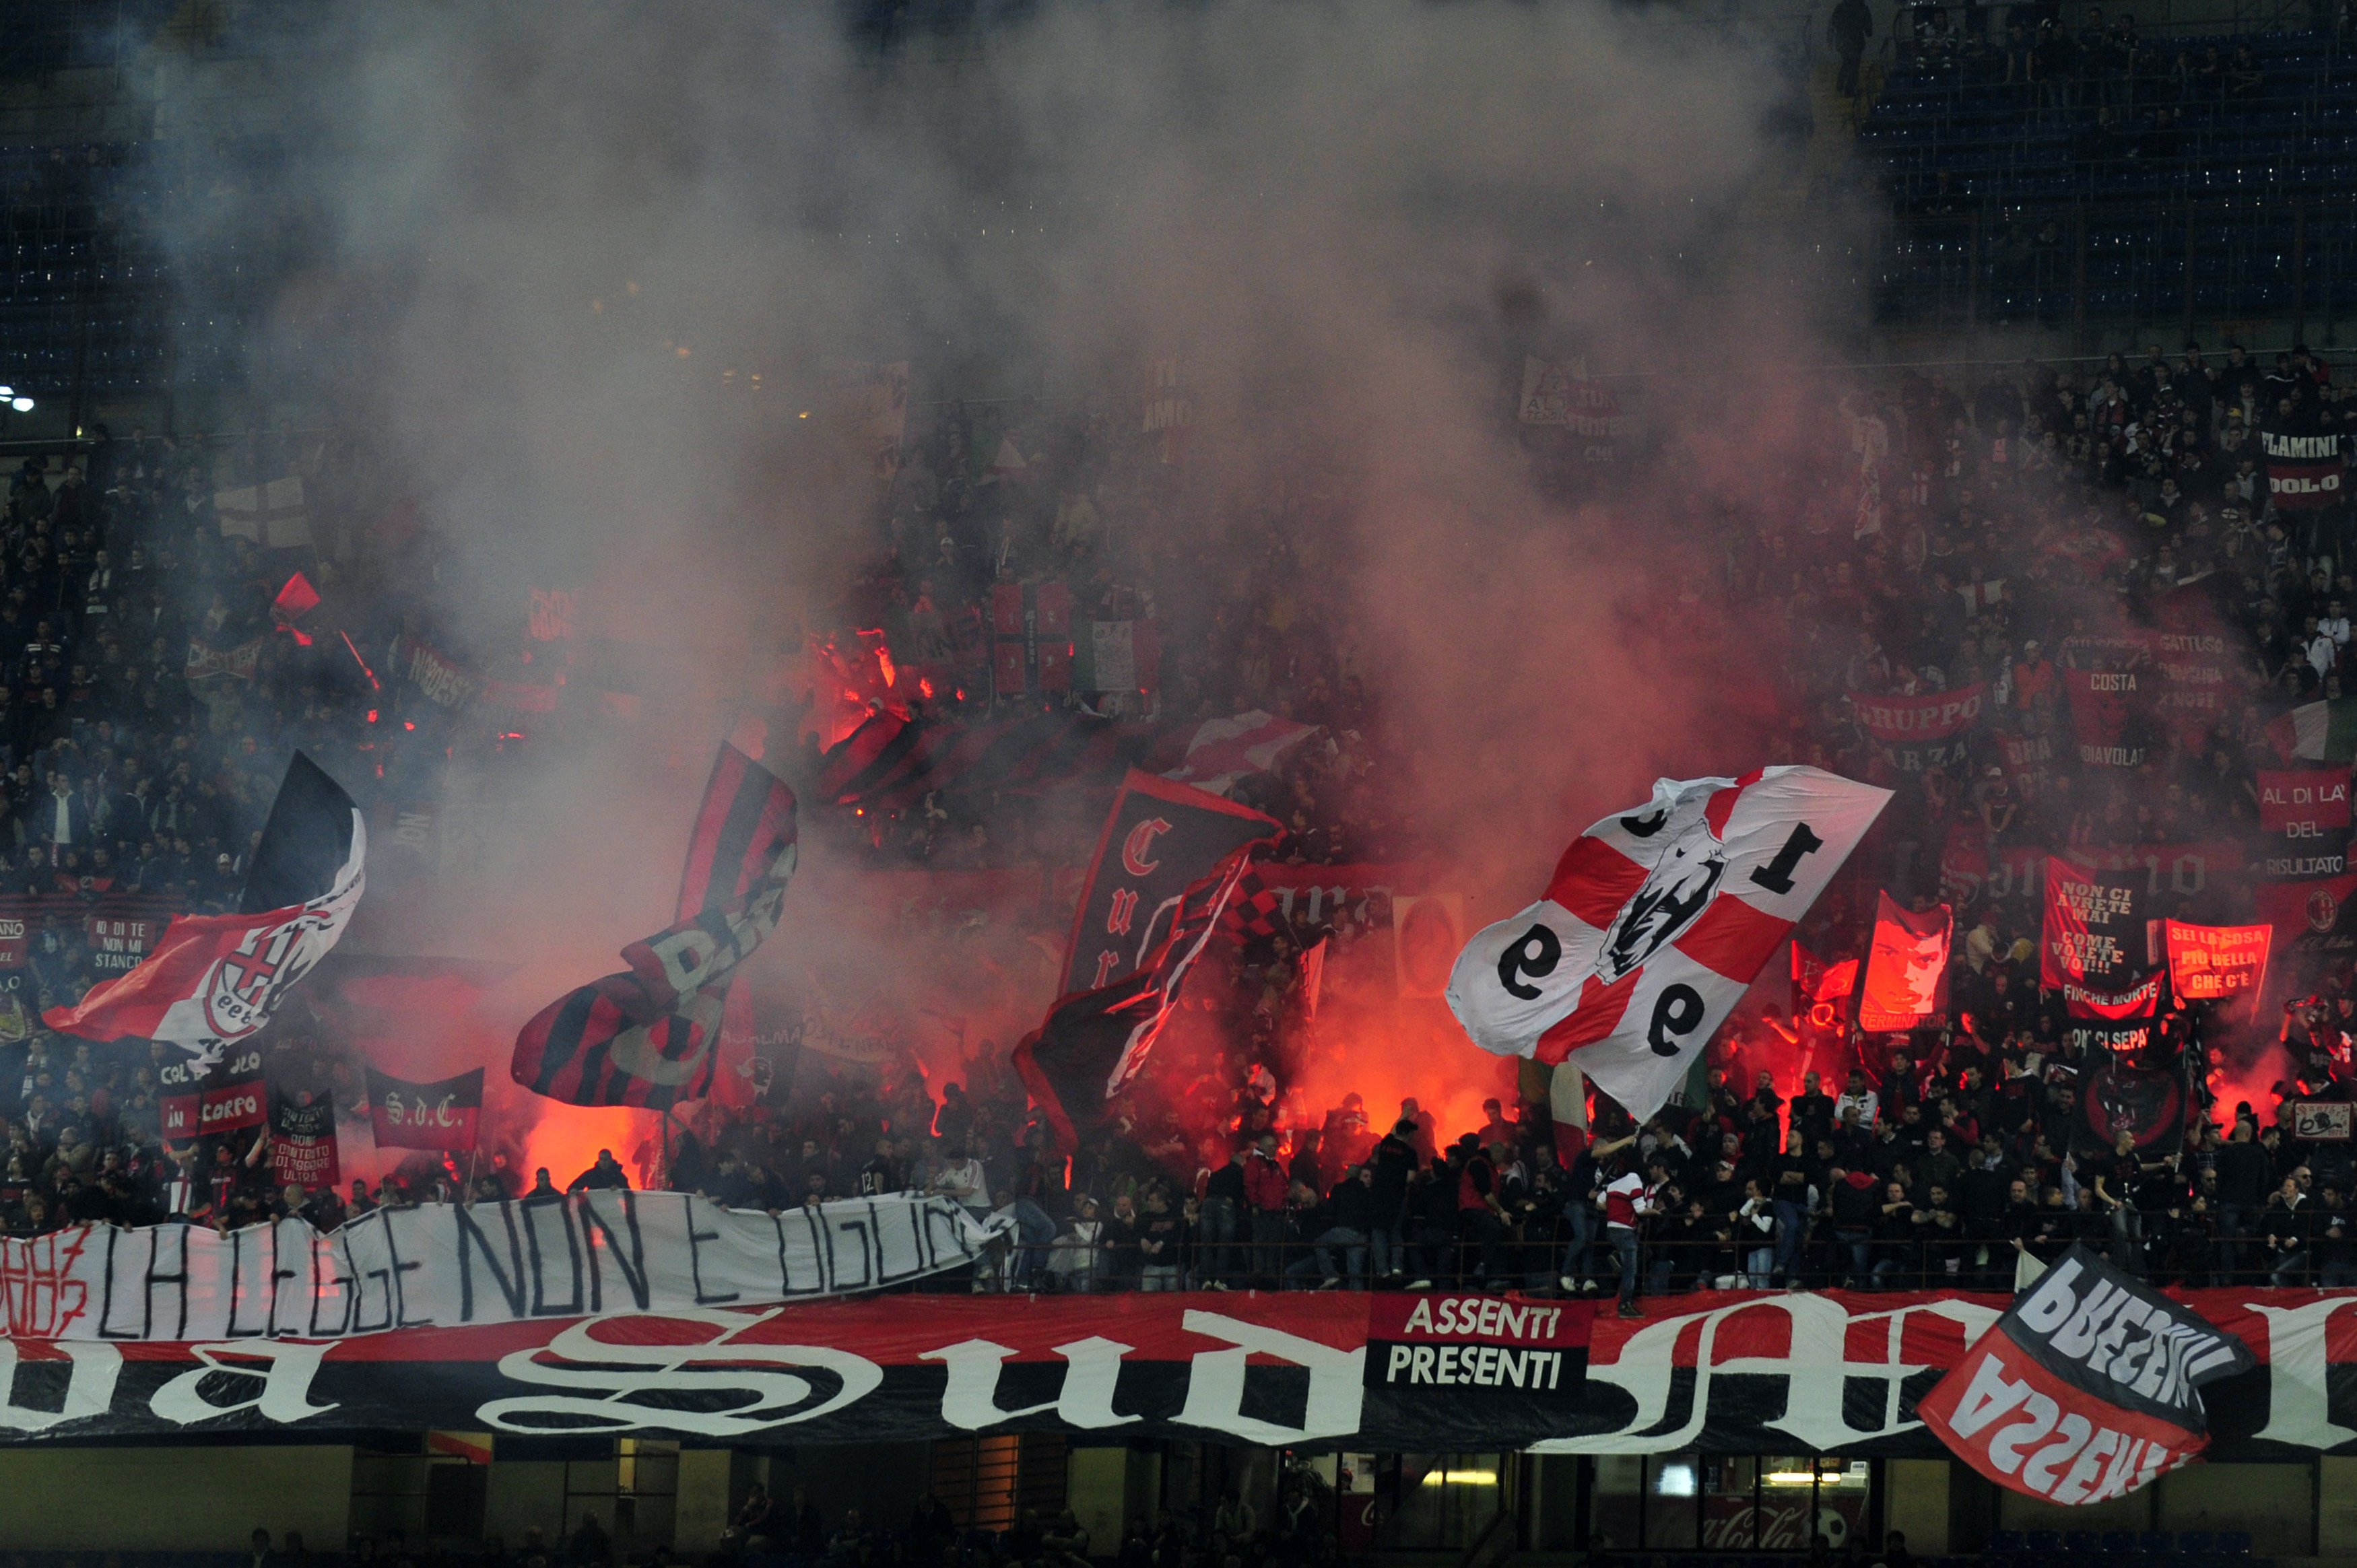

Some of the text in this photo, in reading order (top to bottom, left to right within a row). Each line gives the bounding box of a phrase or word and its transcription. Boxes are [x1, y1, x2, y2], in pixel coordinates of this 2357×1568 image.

[2090, 673, 2137, 691] COSTA
[2263, 788, 2287, 805] AL
[2293, 788, 2312, 804] DI
[2286, 821, 2323, 838] DEL
[2267, 855, 2344, 875] RISULTATO
[2062, 881, 2132, 902] NON CI
[2057, 893, 2132, 915] AVRETE
[2072, 907, 2111, 924] MAI
[96, 920, 146, 937] IO DI TE
[2172, 927, 2264, 945] SEI LA COSA
[102, 937, 142, 953] NON MI
[2061, 931, 2117, 950] COME
[2051, 941, 2125, 964] VOLETE
[2212, 951, 2257, 967] BELLA
[2059, 955, 2111, 974] VOI!!!
[2191, 974, 2222, 990] CHE
[2113, 982, 2158, 1006] MORTE
[1861, 1013, 1947, 1029] TERMINATOR
[2112, 1026, 2150, 1051] SEPA
[161, 1063, 189, 1085] COL
[202, 1095, 257, 1122] CORPO
[275, 1155, 289, 1167] DI
[284, 1169, 319, 1182] ULTRA
[861, 1171, 874, 1193] 12
[454, 1190, 650, 1323] NON
[1404, 1297, 1562, 1339] ASSENTI
[1387, 1344, 1562, 1390] PRESENTI
